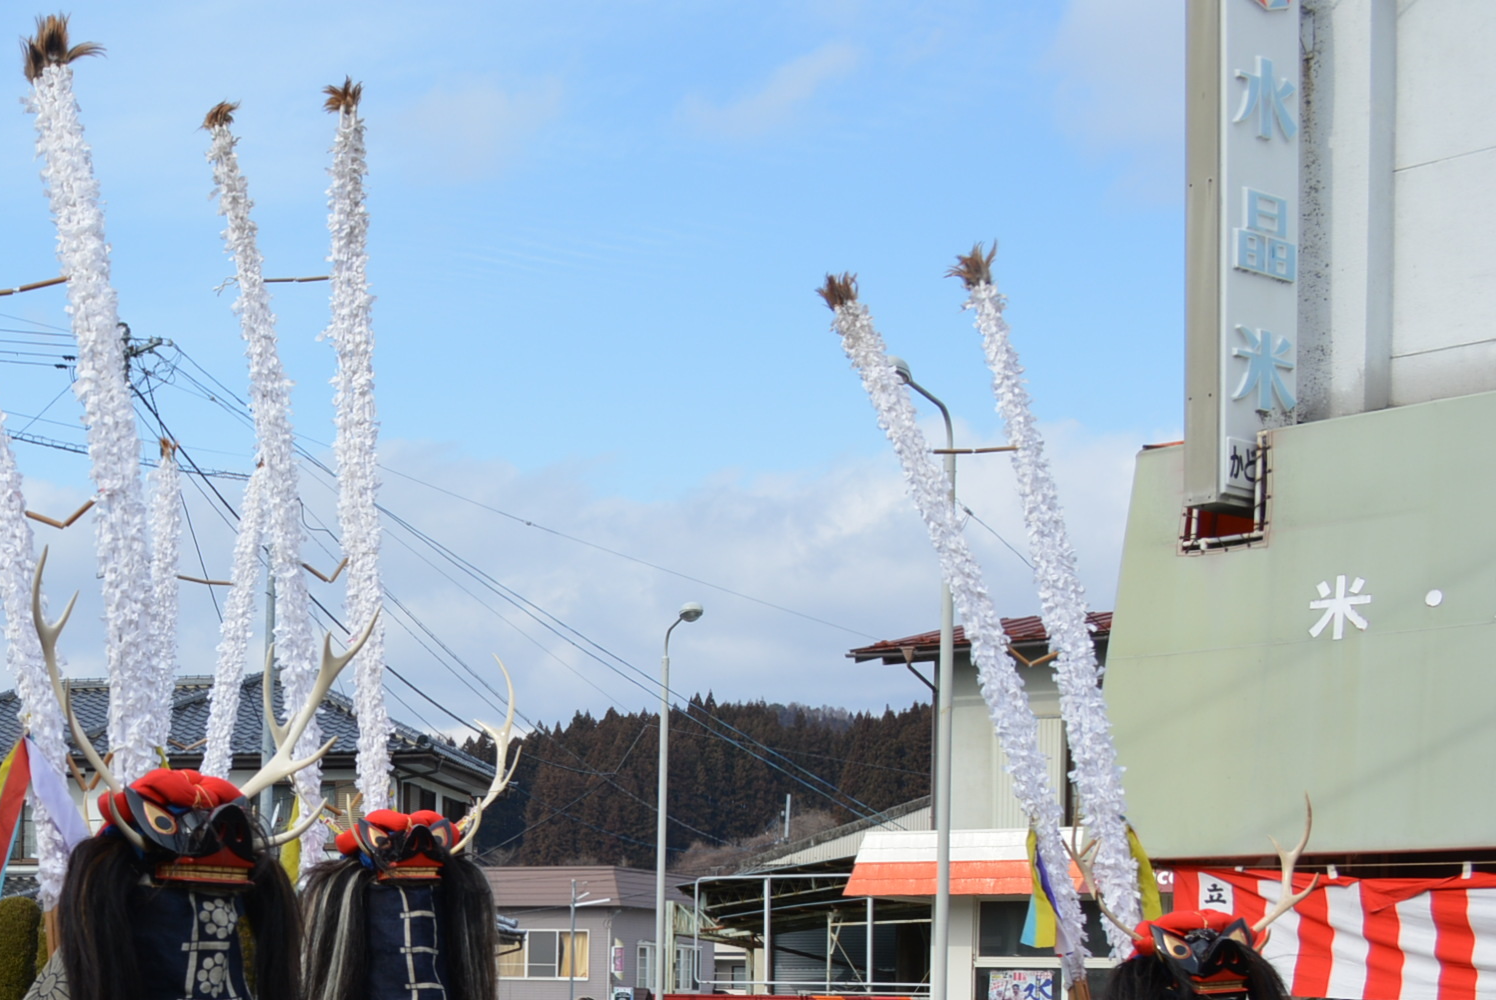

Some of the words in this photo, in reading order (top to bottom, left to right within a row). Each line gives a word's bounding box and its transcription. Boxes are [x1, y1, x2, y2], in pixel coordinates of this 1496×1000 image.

[1232, 55, 1298, 411] 水晶米
[1204, 883, 1227, 904] 立
